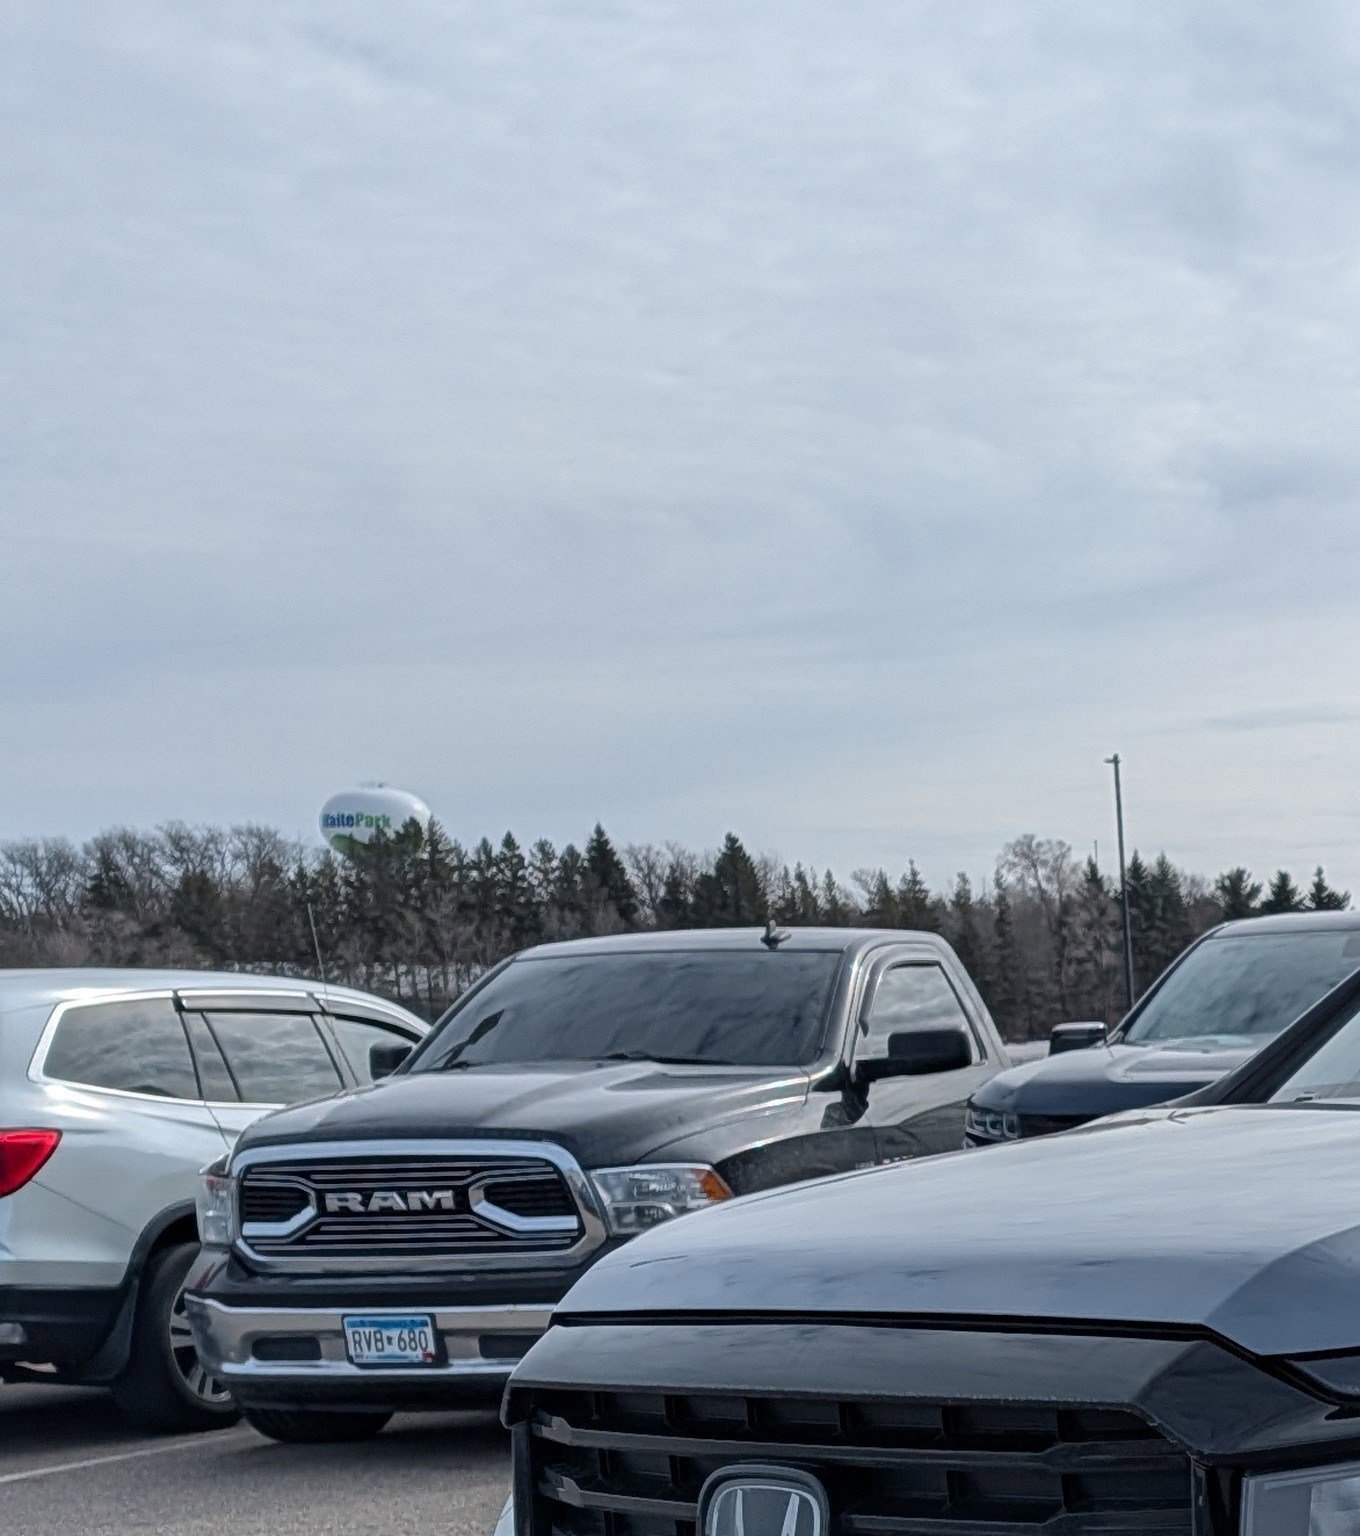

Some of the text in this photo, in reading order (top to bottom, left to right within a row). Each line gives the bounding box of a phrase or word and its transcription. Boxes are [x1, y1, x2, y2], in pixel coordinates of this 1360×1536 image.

[325, 1190, 456, 1212] RAM
[352, 1329, 428, 1353] RVB 680
